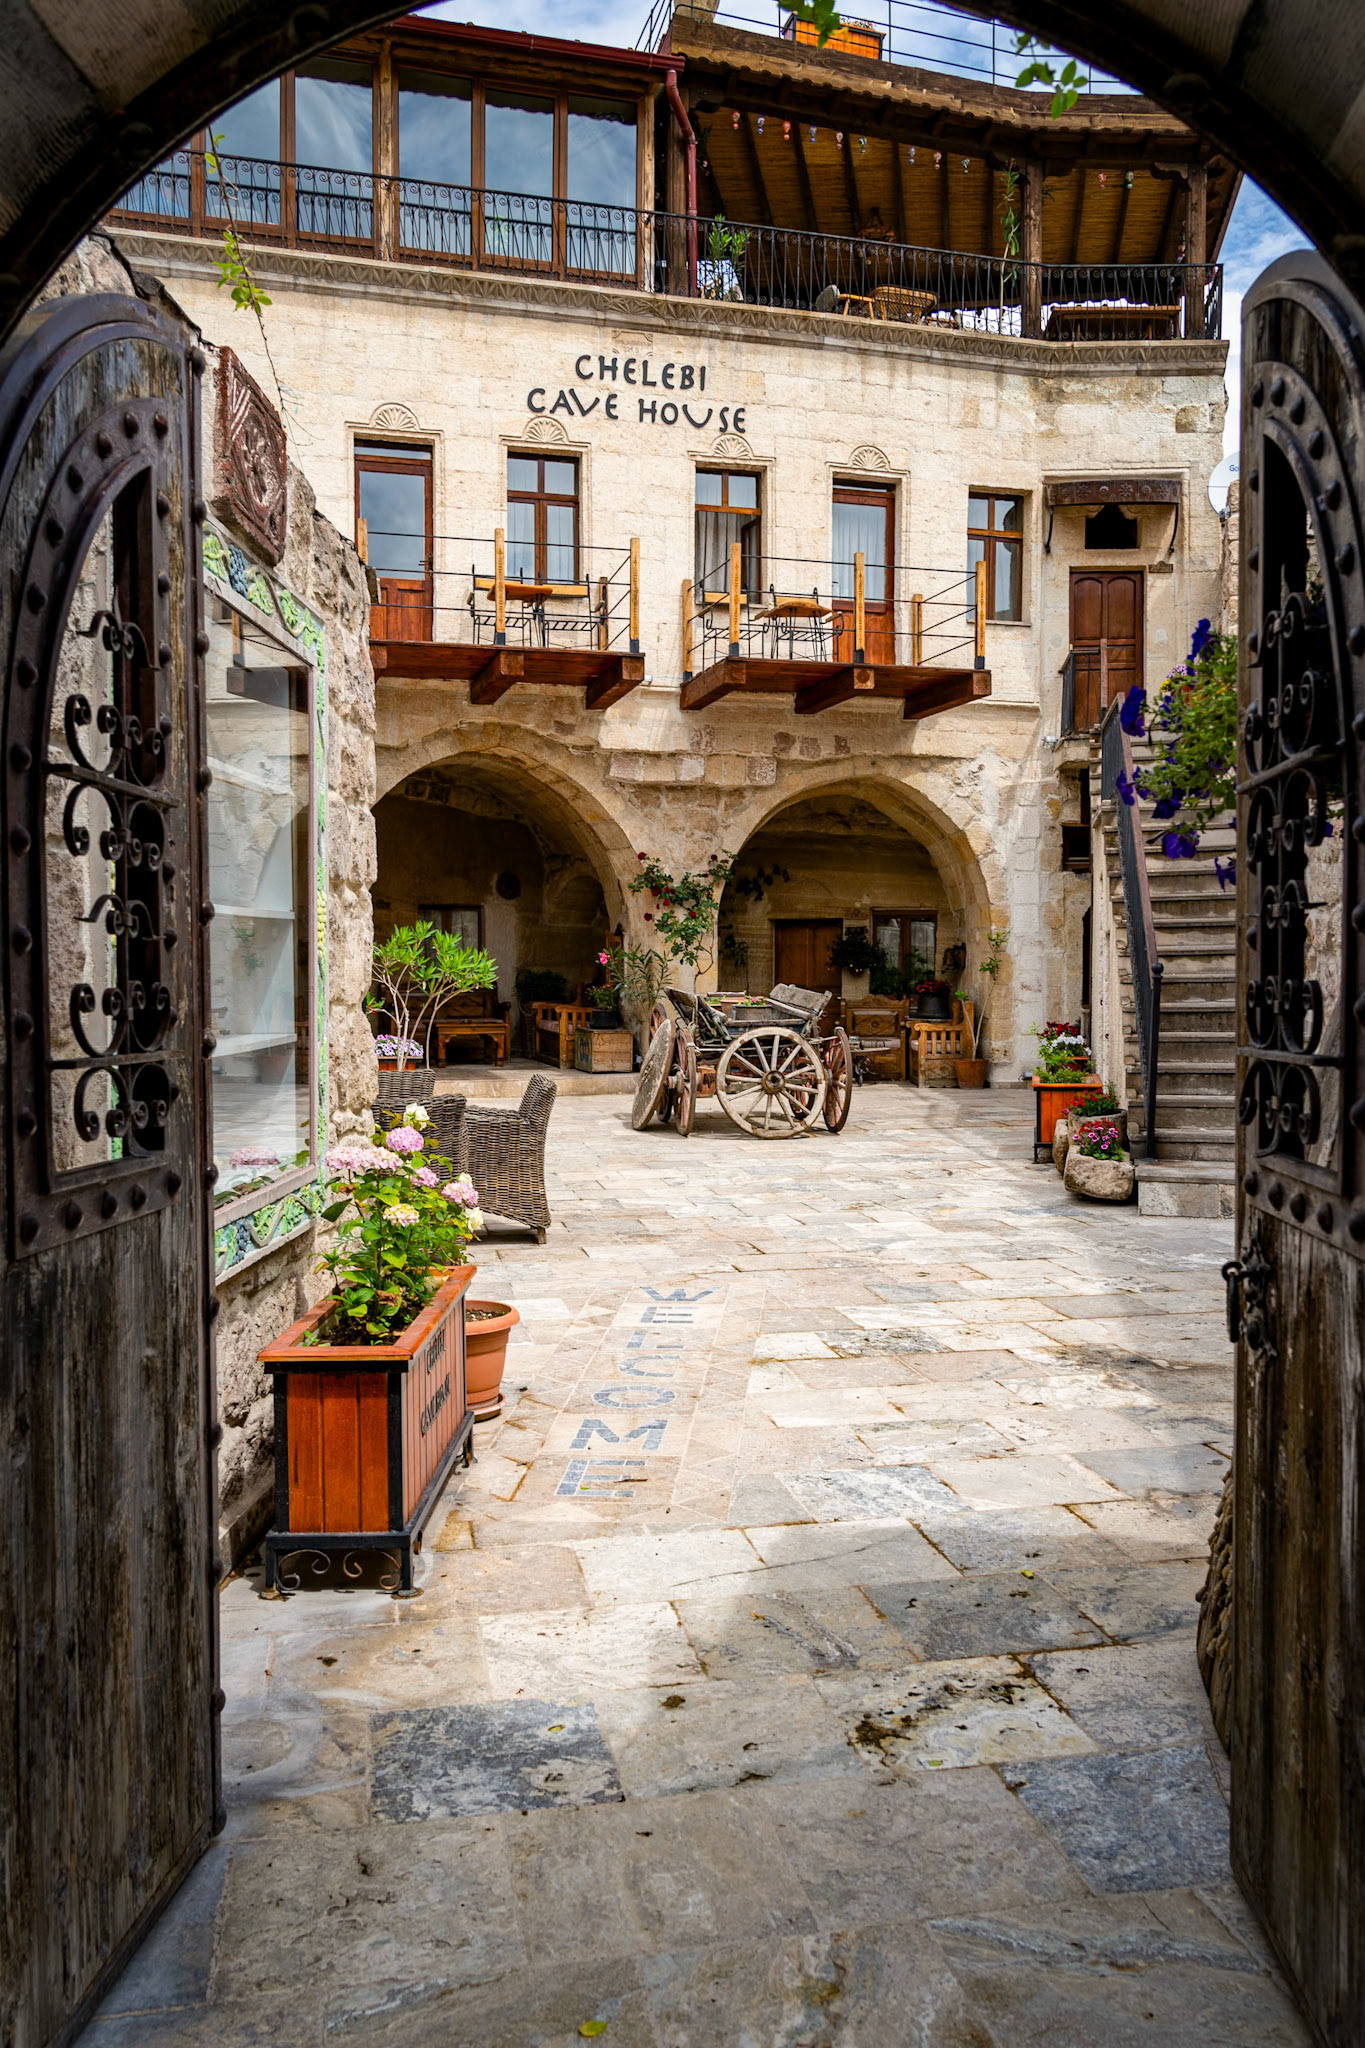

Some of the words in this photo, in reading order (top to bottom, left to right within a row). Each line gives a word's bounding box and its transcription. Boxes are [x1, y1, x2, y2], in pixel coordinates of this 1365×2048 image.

[575, 354, 706, 391] CHELEBI
[527, 387, 619, 420] CAVE
[638, 398, 746, 433] HOUSE
[555, 1286, 723, 1497] WELCOME
